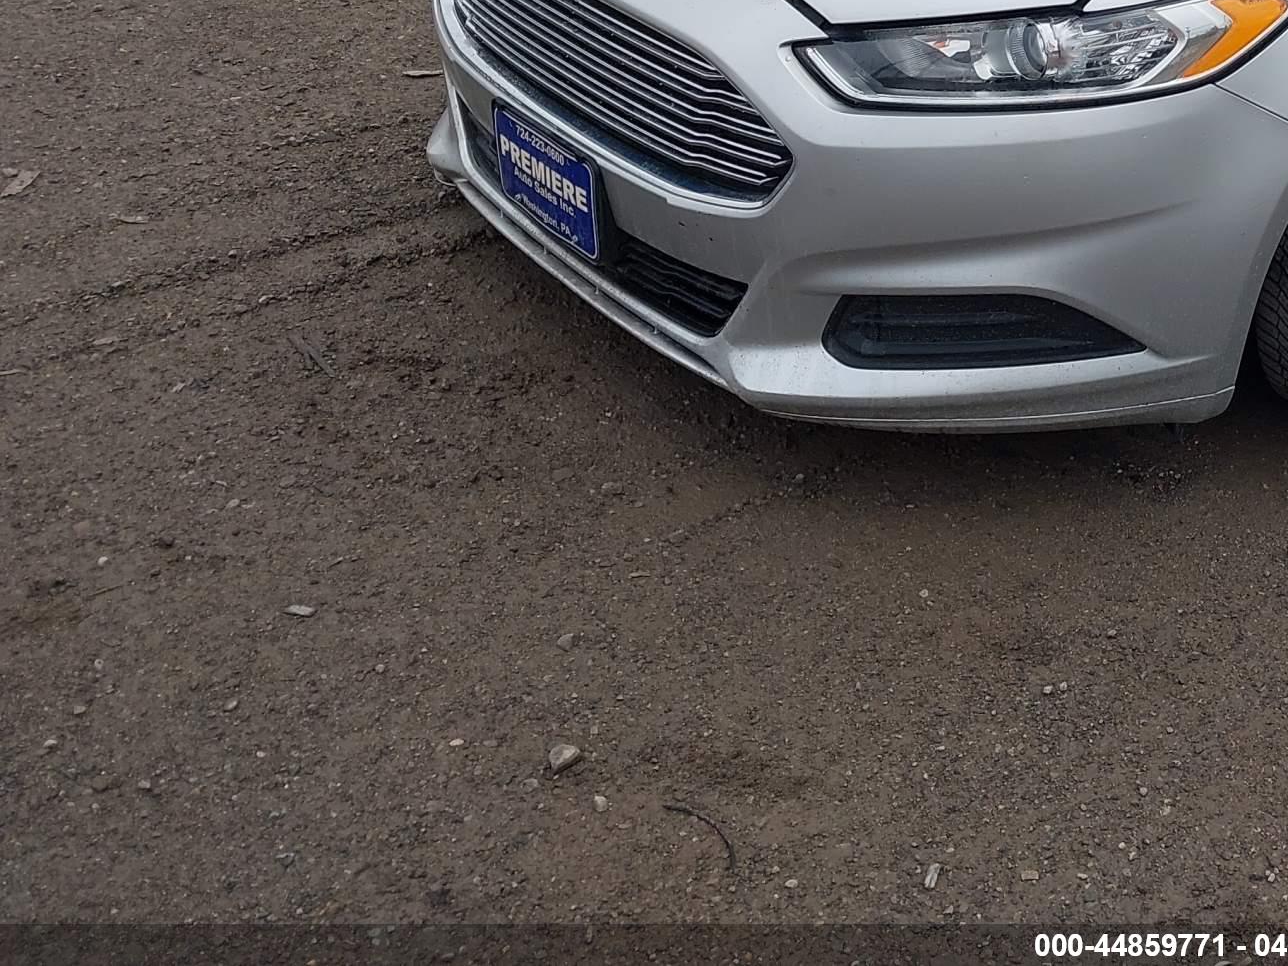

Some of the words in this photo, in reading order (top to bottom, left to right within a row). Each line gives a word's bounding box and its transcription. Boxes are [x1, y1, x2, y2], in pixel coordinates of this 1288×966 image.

[500, 133, 588, 213] PREMIERE
[514, 165, 533, 188] Auto
[534, 180, 558, 206] Sales
[559, 197, 577, 219] Inc.
[560, 222, 572, 236] PA
